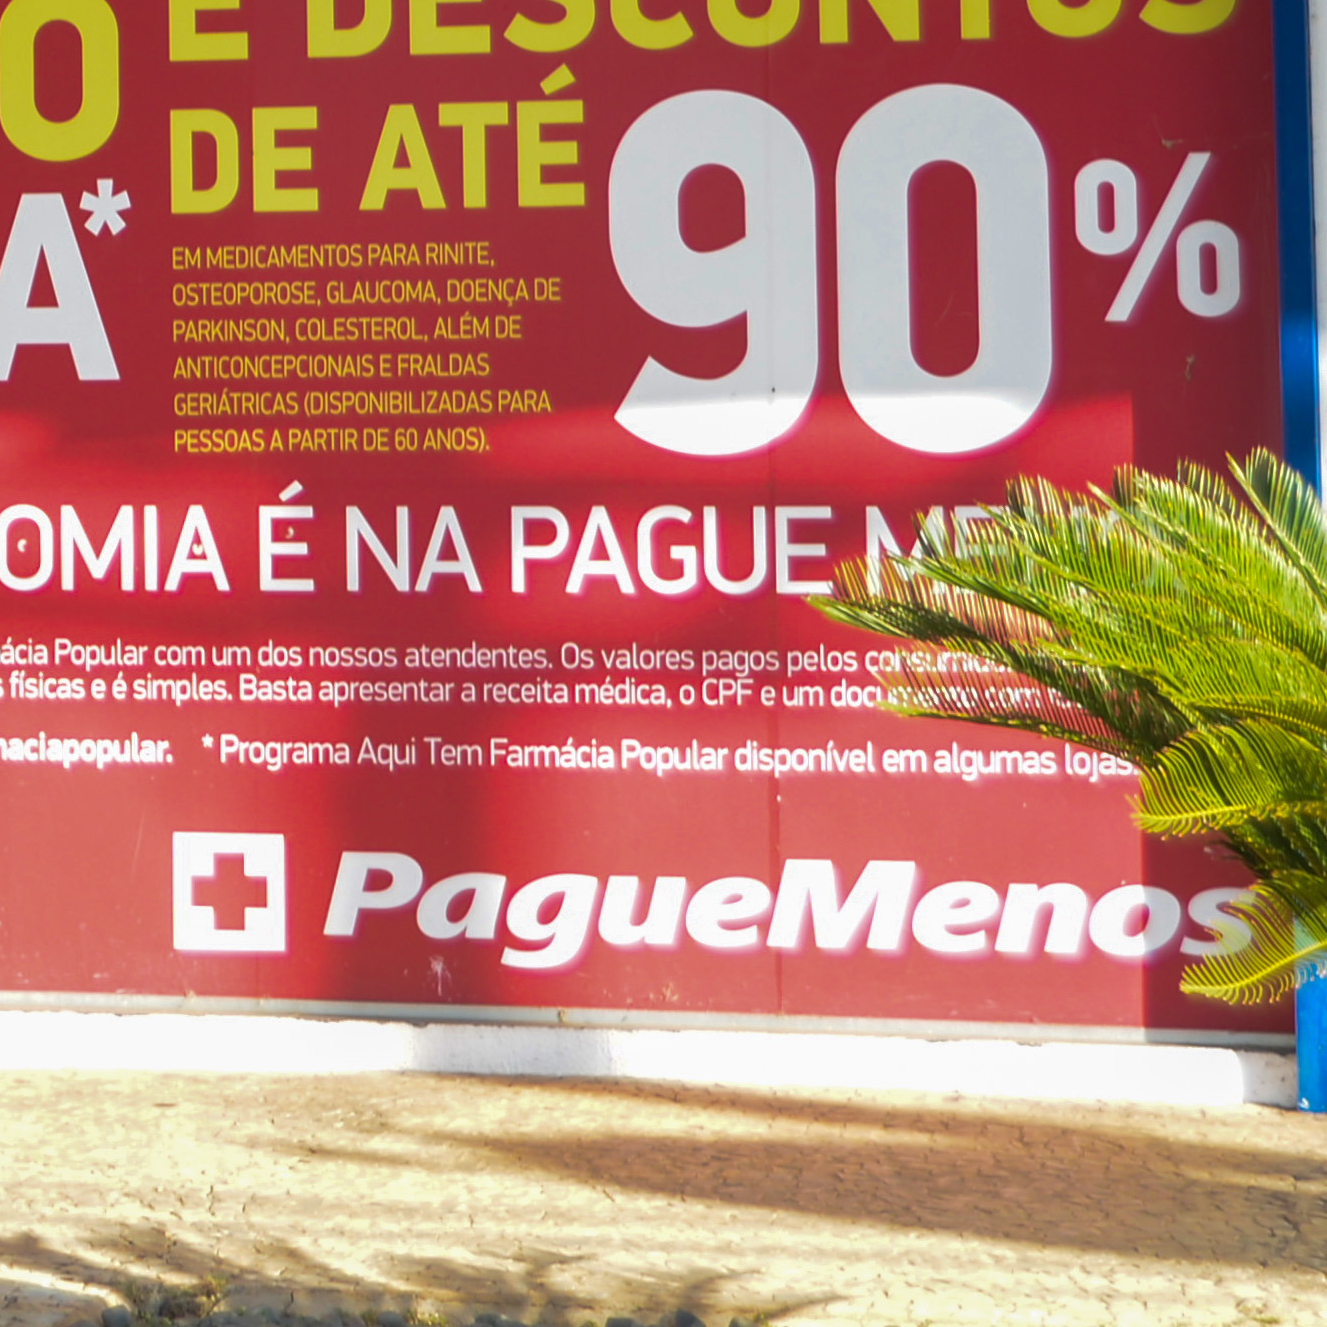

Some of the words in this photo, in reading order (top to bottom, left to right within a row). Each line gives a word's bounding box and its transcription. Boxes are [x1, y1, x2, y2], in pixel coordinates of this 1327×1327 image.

[170, 106, 319, 215] DE
[359, 65, 586, 212] ATÉ
[172, 247, 201, 269] EM
[206, 244, 362, 269] MEDICAMENTOS
[367, 243, 420, 267] PARA
[425, 241, 495, 268] RINITE,
[172, 281, 321, 306] OSTEOPOROSE,
[326, 279, 441, 305] GLAUCOMA,
[446, 278, 529, 306] DOENÇA
[534, 277, 561, 301] DE
[173, 319, 290, 343] PARKINSON,
[295, 316, 428, 342] COLESTEROL,
[433, 312, 489, 340] ALÉM
[495, 315, 522, 339] DE
[174, 354, 374, 379] ANTICONCEPCIONAIS
[380, 354, 392, 376] E
[397, 353, 489, 376] FRALDAS
[174, 388, 298, 416] GERIÁTRICAS
[304, 389, 492, 417] (DISPONIBILIZADAS
[497, 390, 552, 413] PARA
[174, 429, 264, 452] PESSOAS
[269, 429, 284, 451] A
[288, 428, 358, 452] PARTIR
[363, 428, 389, 451] DE
[394, 428, 418, 450] 60
[422, 427, 490, 453] ANOS).
[258, 479, 315, 592] É
[345, 504, 483, 594] NA
[510, 504, 833, 597] PAGUE
[55, 639, 147, 672] Popular
[154, 645, 205, 666] com
[212, 646, 251, 667] um
[258, 640, 302, 667] dos
[309, 646, 397, 668] nossos
[404, 641, 553, 670] atendentes.
[560, 643, 594, 670] Os
[601, 643, 694, 671] valores
[702, 650, 780, 677] pagos
[787, 644, 857, 675] pelos
[10, 671, 85, 700] físicas
[90, 679, 107, 701] e
[112, 672, 127, 701] é
[132, 674, 232, 706] simples.
[239, 674, 312, 702] Basta
[318, 678, 455, 707] apresentar
[461, 682, 476, 703] a
[482, 678, 568, 704] receita
[574, 678, 672, 709] médica,
[679, 683, 695, 705] o
[701, 678, 755, 706] CPF
[760, 685, 775, 706] e
[781, 685, 824, 707] um
[357, 737, 416, 772] Aqui
[423, 736, 483, 766] Tem
[489, 737, 614, 770] Farmácia
[620, 739, 728, 775] Popular
[734, 740, 875, 776] disponível
[882, 747, 926, 772] em
[934, 742, 1056, 782] algumas
[324, 850, 1259, 970] PagueMenos
